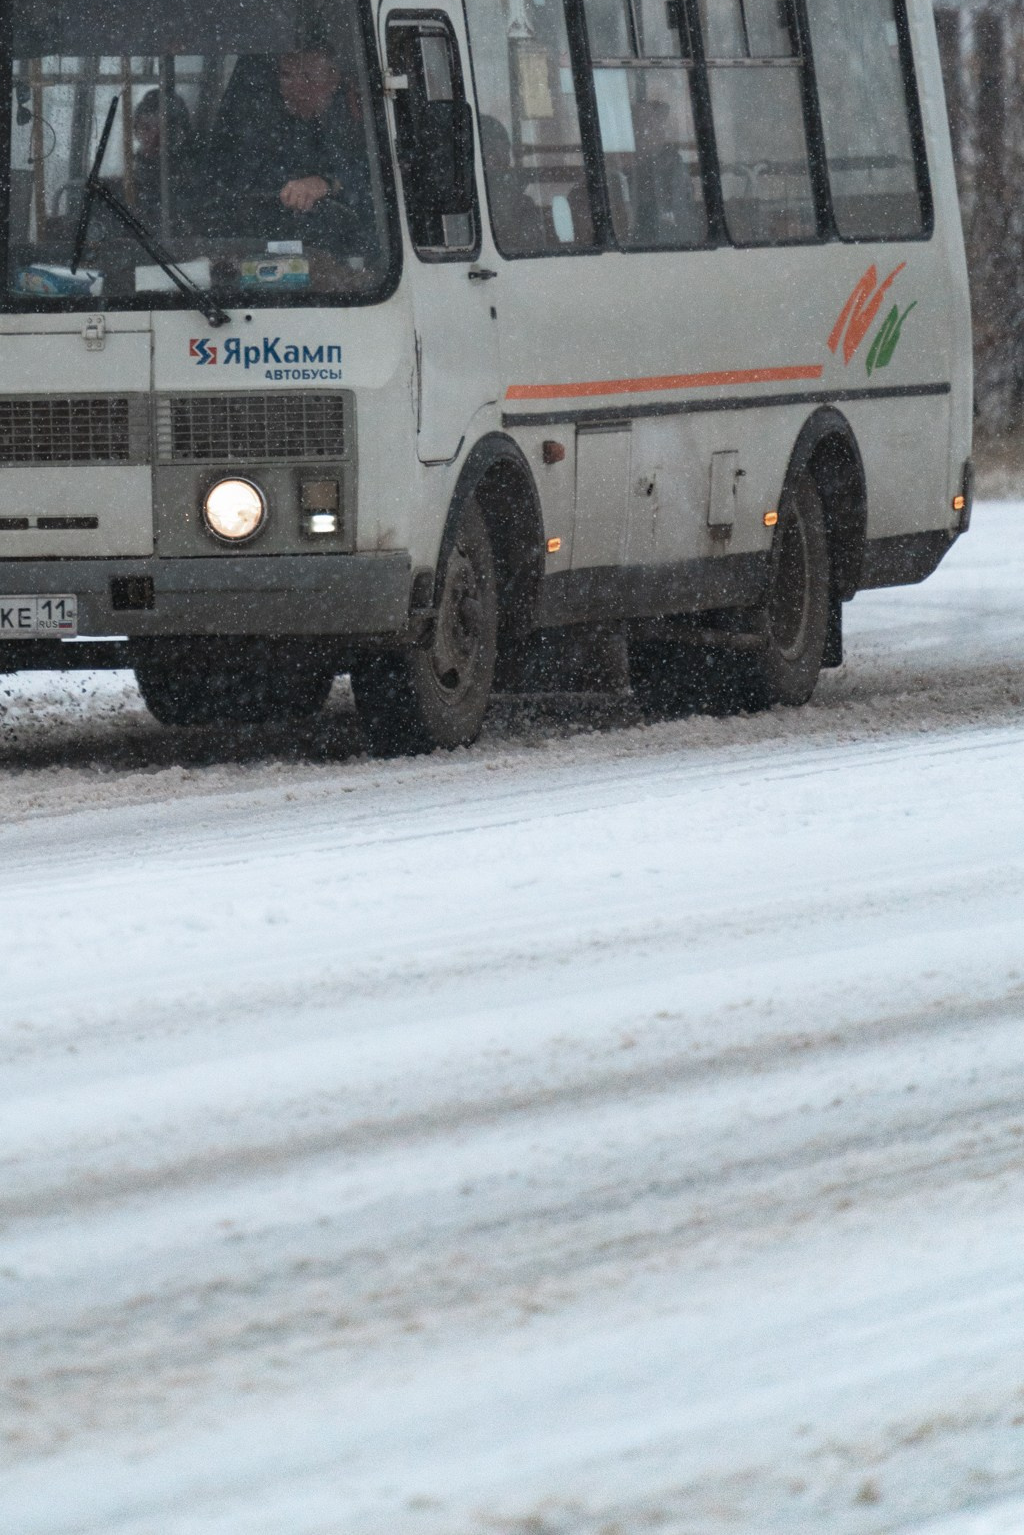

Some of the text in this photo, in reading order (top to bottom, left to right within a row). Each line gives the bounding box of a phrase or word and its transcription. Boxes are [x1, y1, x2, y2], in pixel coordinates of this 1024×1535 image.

[223, 337, 342, 369] ЯрКамп
[265, 369, 342, 380] АВТОБУСЫ
[41, 600, 66, 620] 11
[39, 620, 58, 628] RUS
